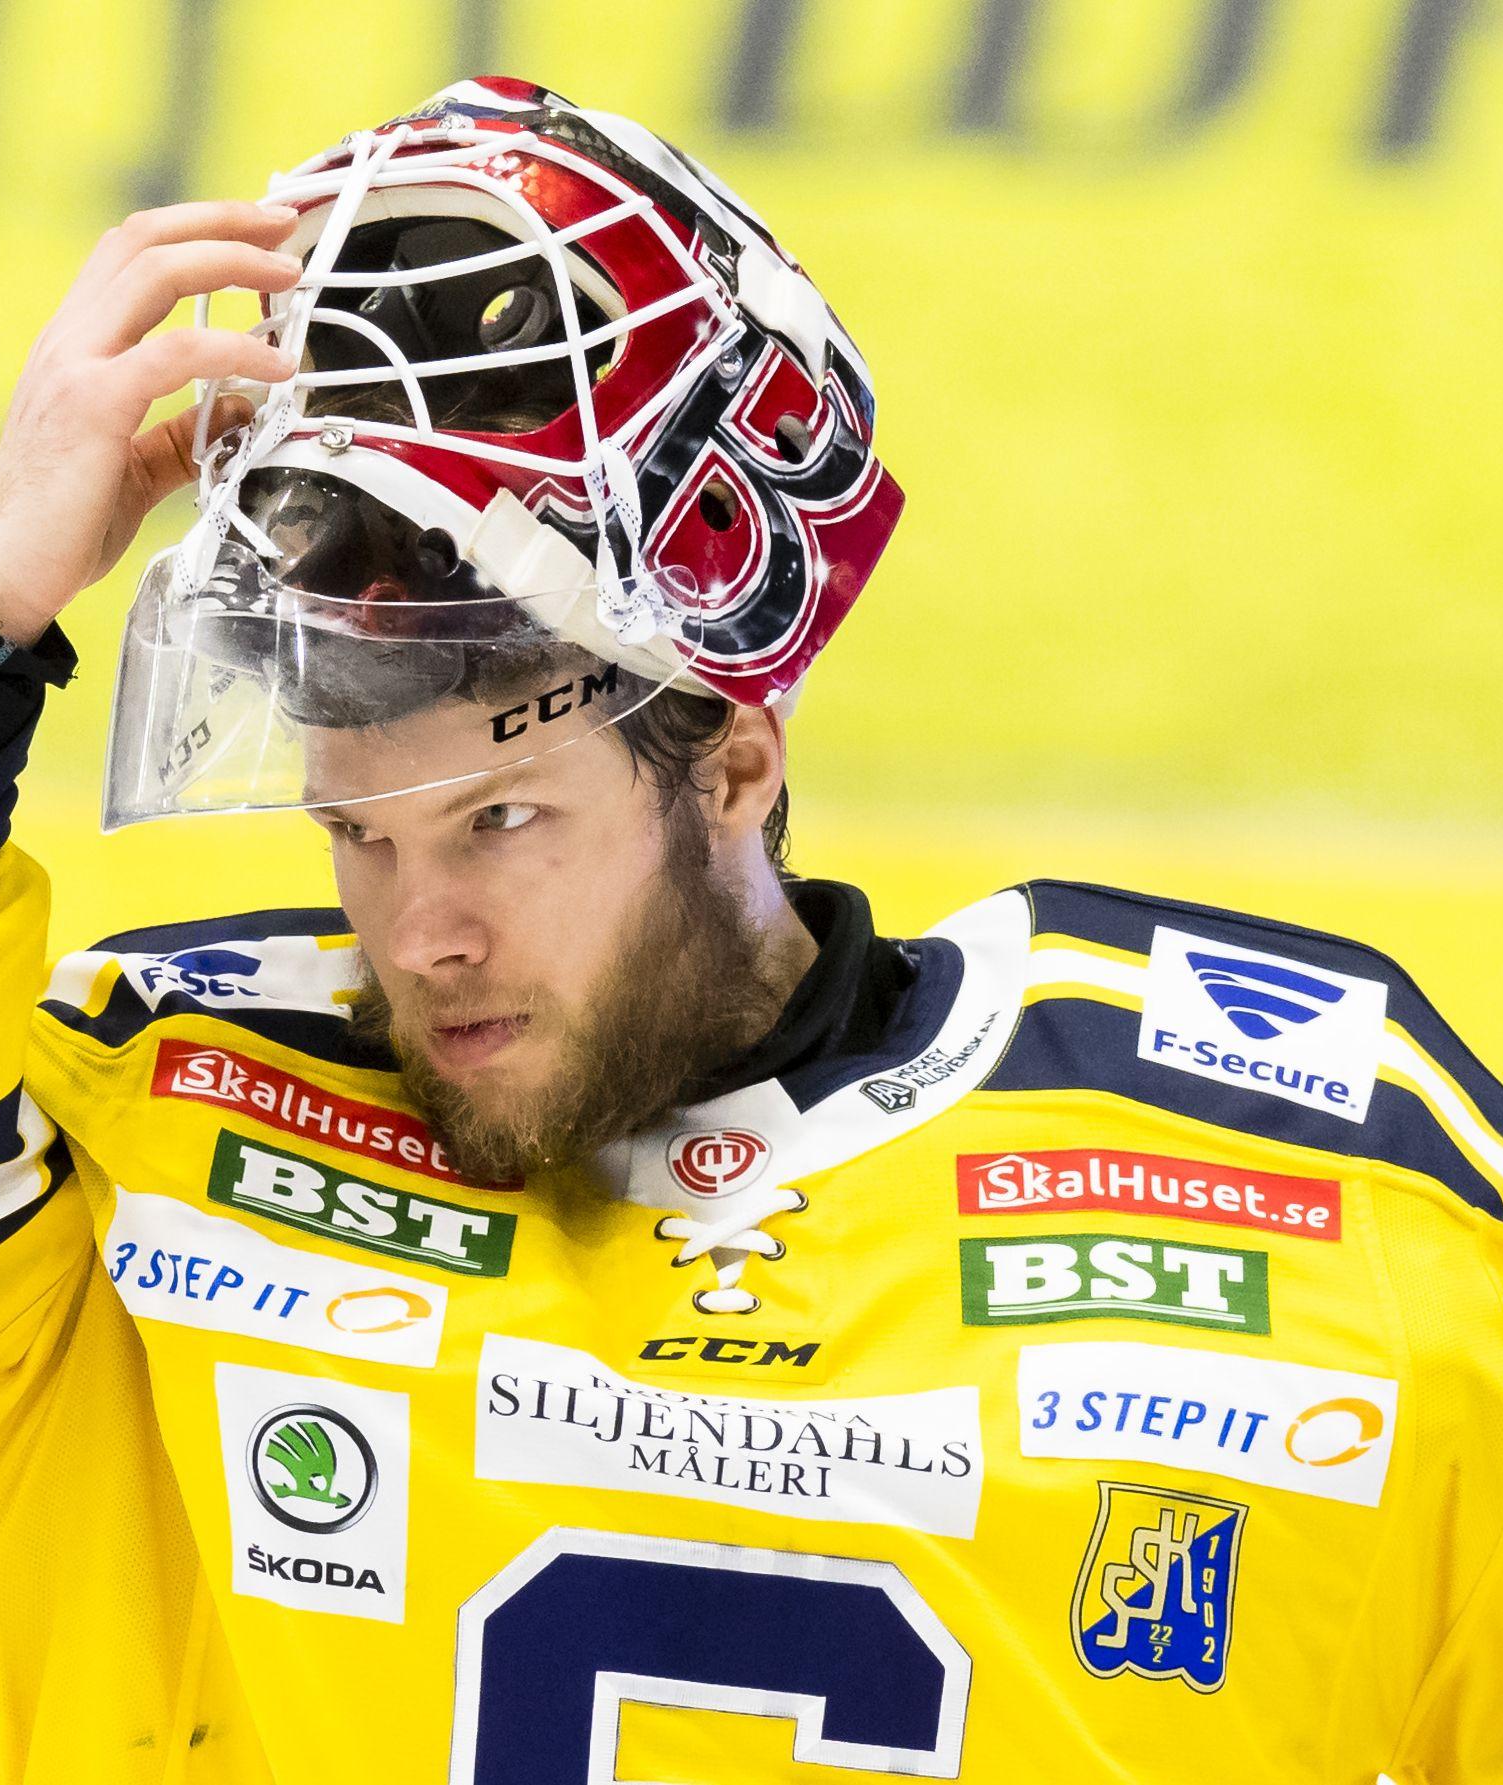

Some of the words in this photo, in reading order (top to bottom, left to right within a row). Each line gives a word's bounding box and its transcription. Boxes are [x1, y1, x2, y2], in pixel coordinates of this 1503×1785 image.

[488, 662, 618, 745] CCM
[891, 1047, 950, 1080] HOCKEY
[911, 1011, 1001, 1089] ALLSVENSKAN
[232, 1145, 490, 1259] BST
[980, 1157, 1330, 1229] SkalHuset.se
[109, 1242, 137, 1283] 3
[138, 1248, 244, 1302] STEP
[254, 1284, 309, 1319] IT
[985, 1240, 1244, 1313] BST
[638, 1336, 821, 1367] CCM
[489, 1373, 971, 1478] SILJENDAHLS
[1032, 1391, 1060, 1430] 3
[1076, 1391, 1206, 1441] STEP
[1217, 1414, 1268, 1454] IT
[628, 1443, 831, 1498] MÅLERI
[248, 1543, 385, 1595] ŠKODA
